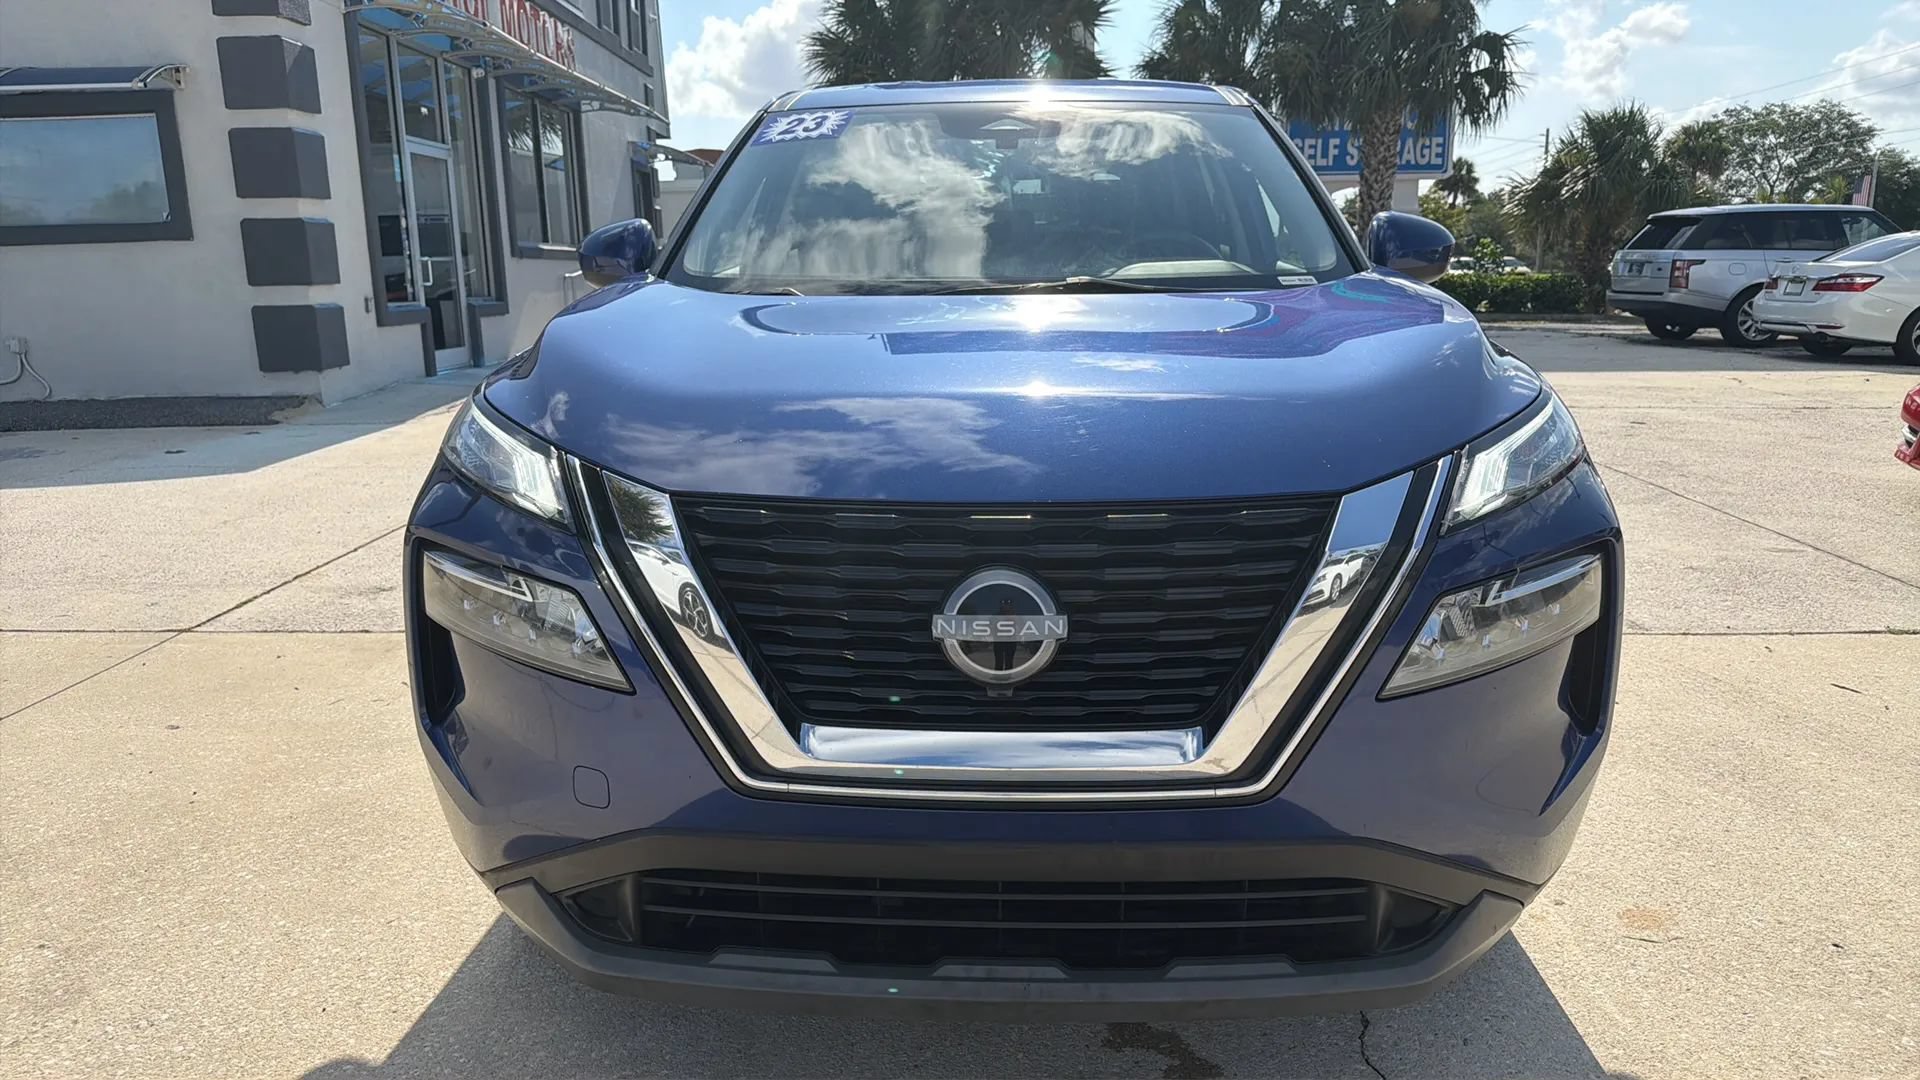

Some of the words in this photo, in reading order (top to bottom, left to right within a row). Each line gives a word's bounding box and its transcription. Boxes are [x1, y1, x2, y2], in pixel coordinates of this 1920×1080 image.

[499, 0, 576, 71] MOTORS
[776, 115, 828, 136] 23
[1345, 136, 1443, 166] SAGE
[936, 618, 1064, 636] NISSAN
